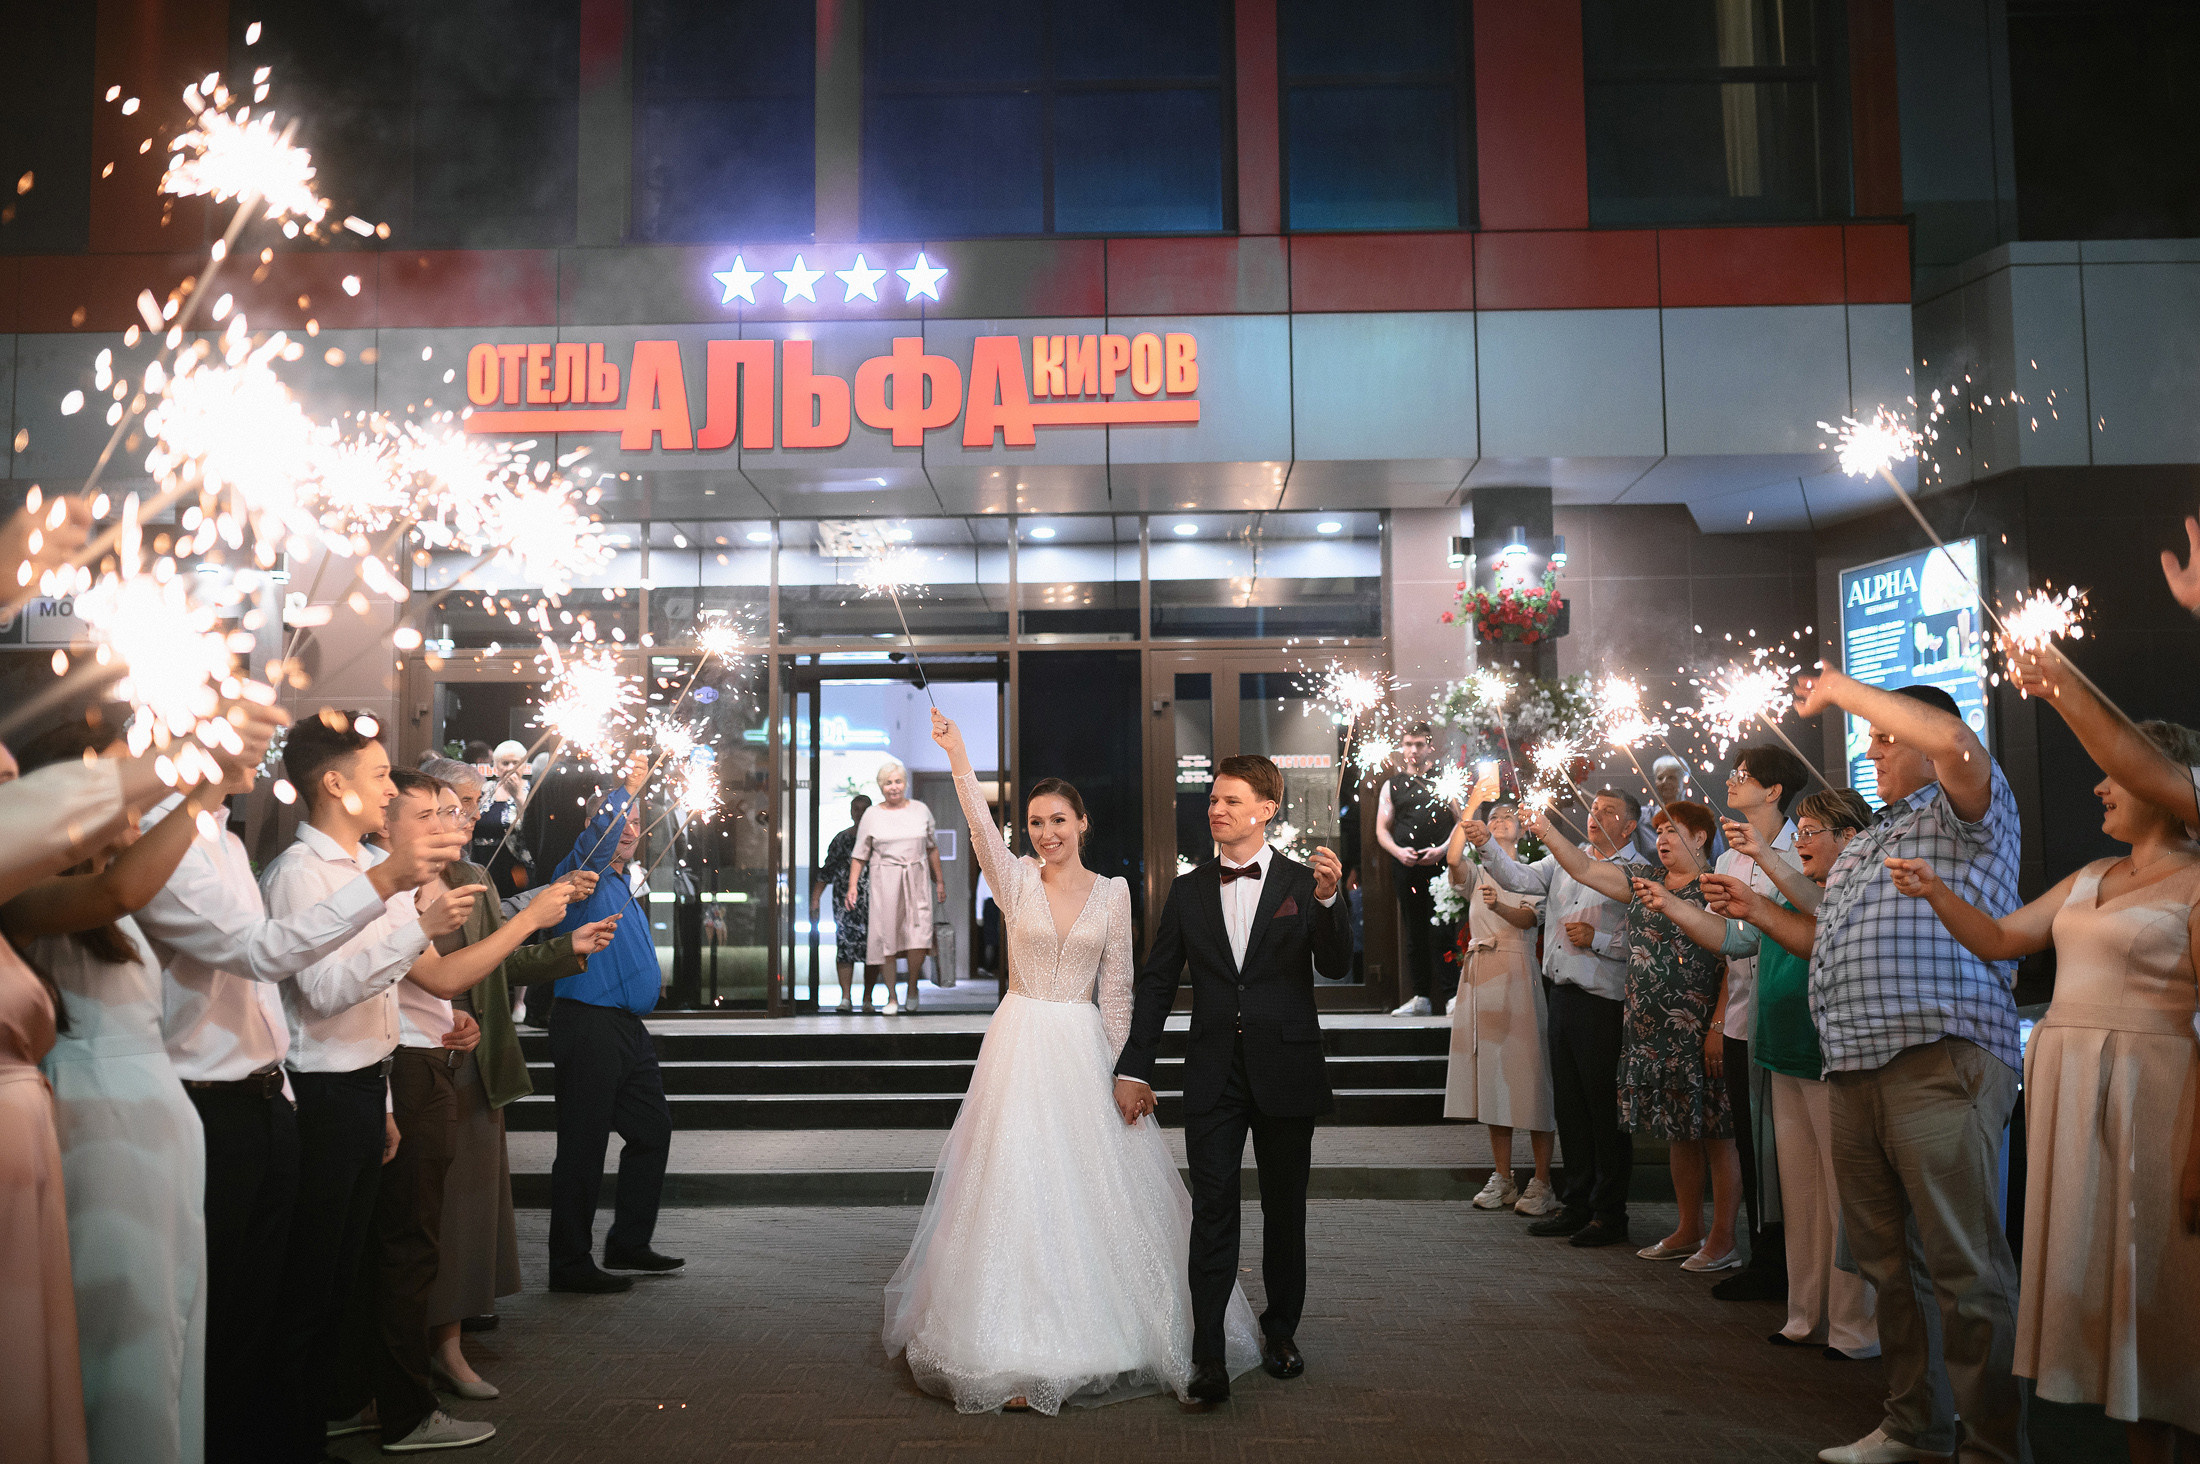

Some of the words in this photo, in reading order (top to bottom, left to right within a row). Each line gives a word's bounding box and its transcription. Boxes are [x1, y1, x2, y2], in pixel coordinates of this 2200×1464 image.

[467, 342, 620, 406] ОТЕЛЬ
[620, 336, 1036, 450] АЛЬФА
[1033, 332, 1199, 396] КИРОВ
[1847, 566, 1918, 608] ALPHA
